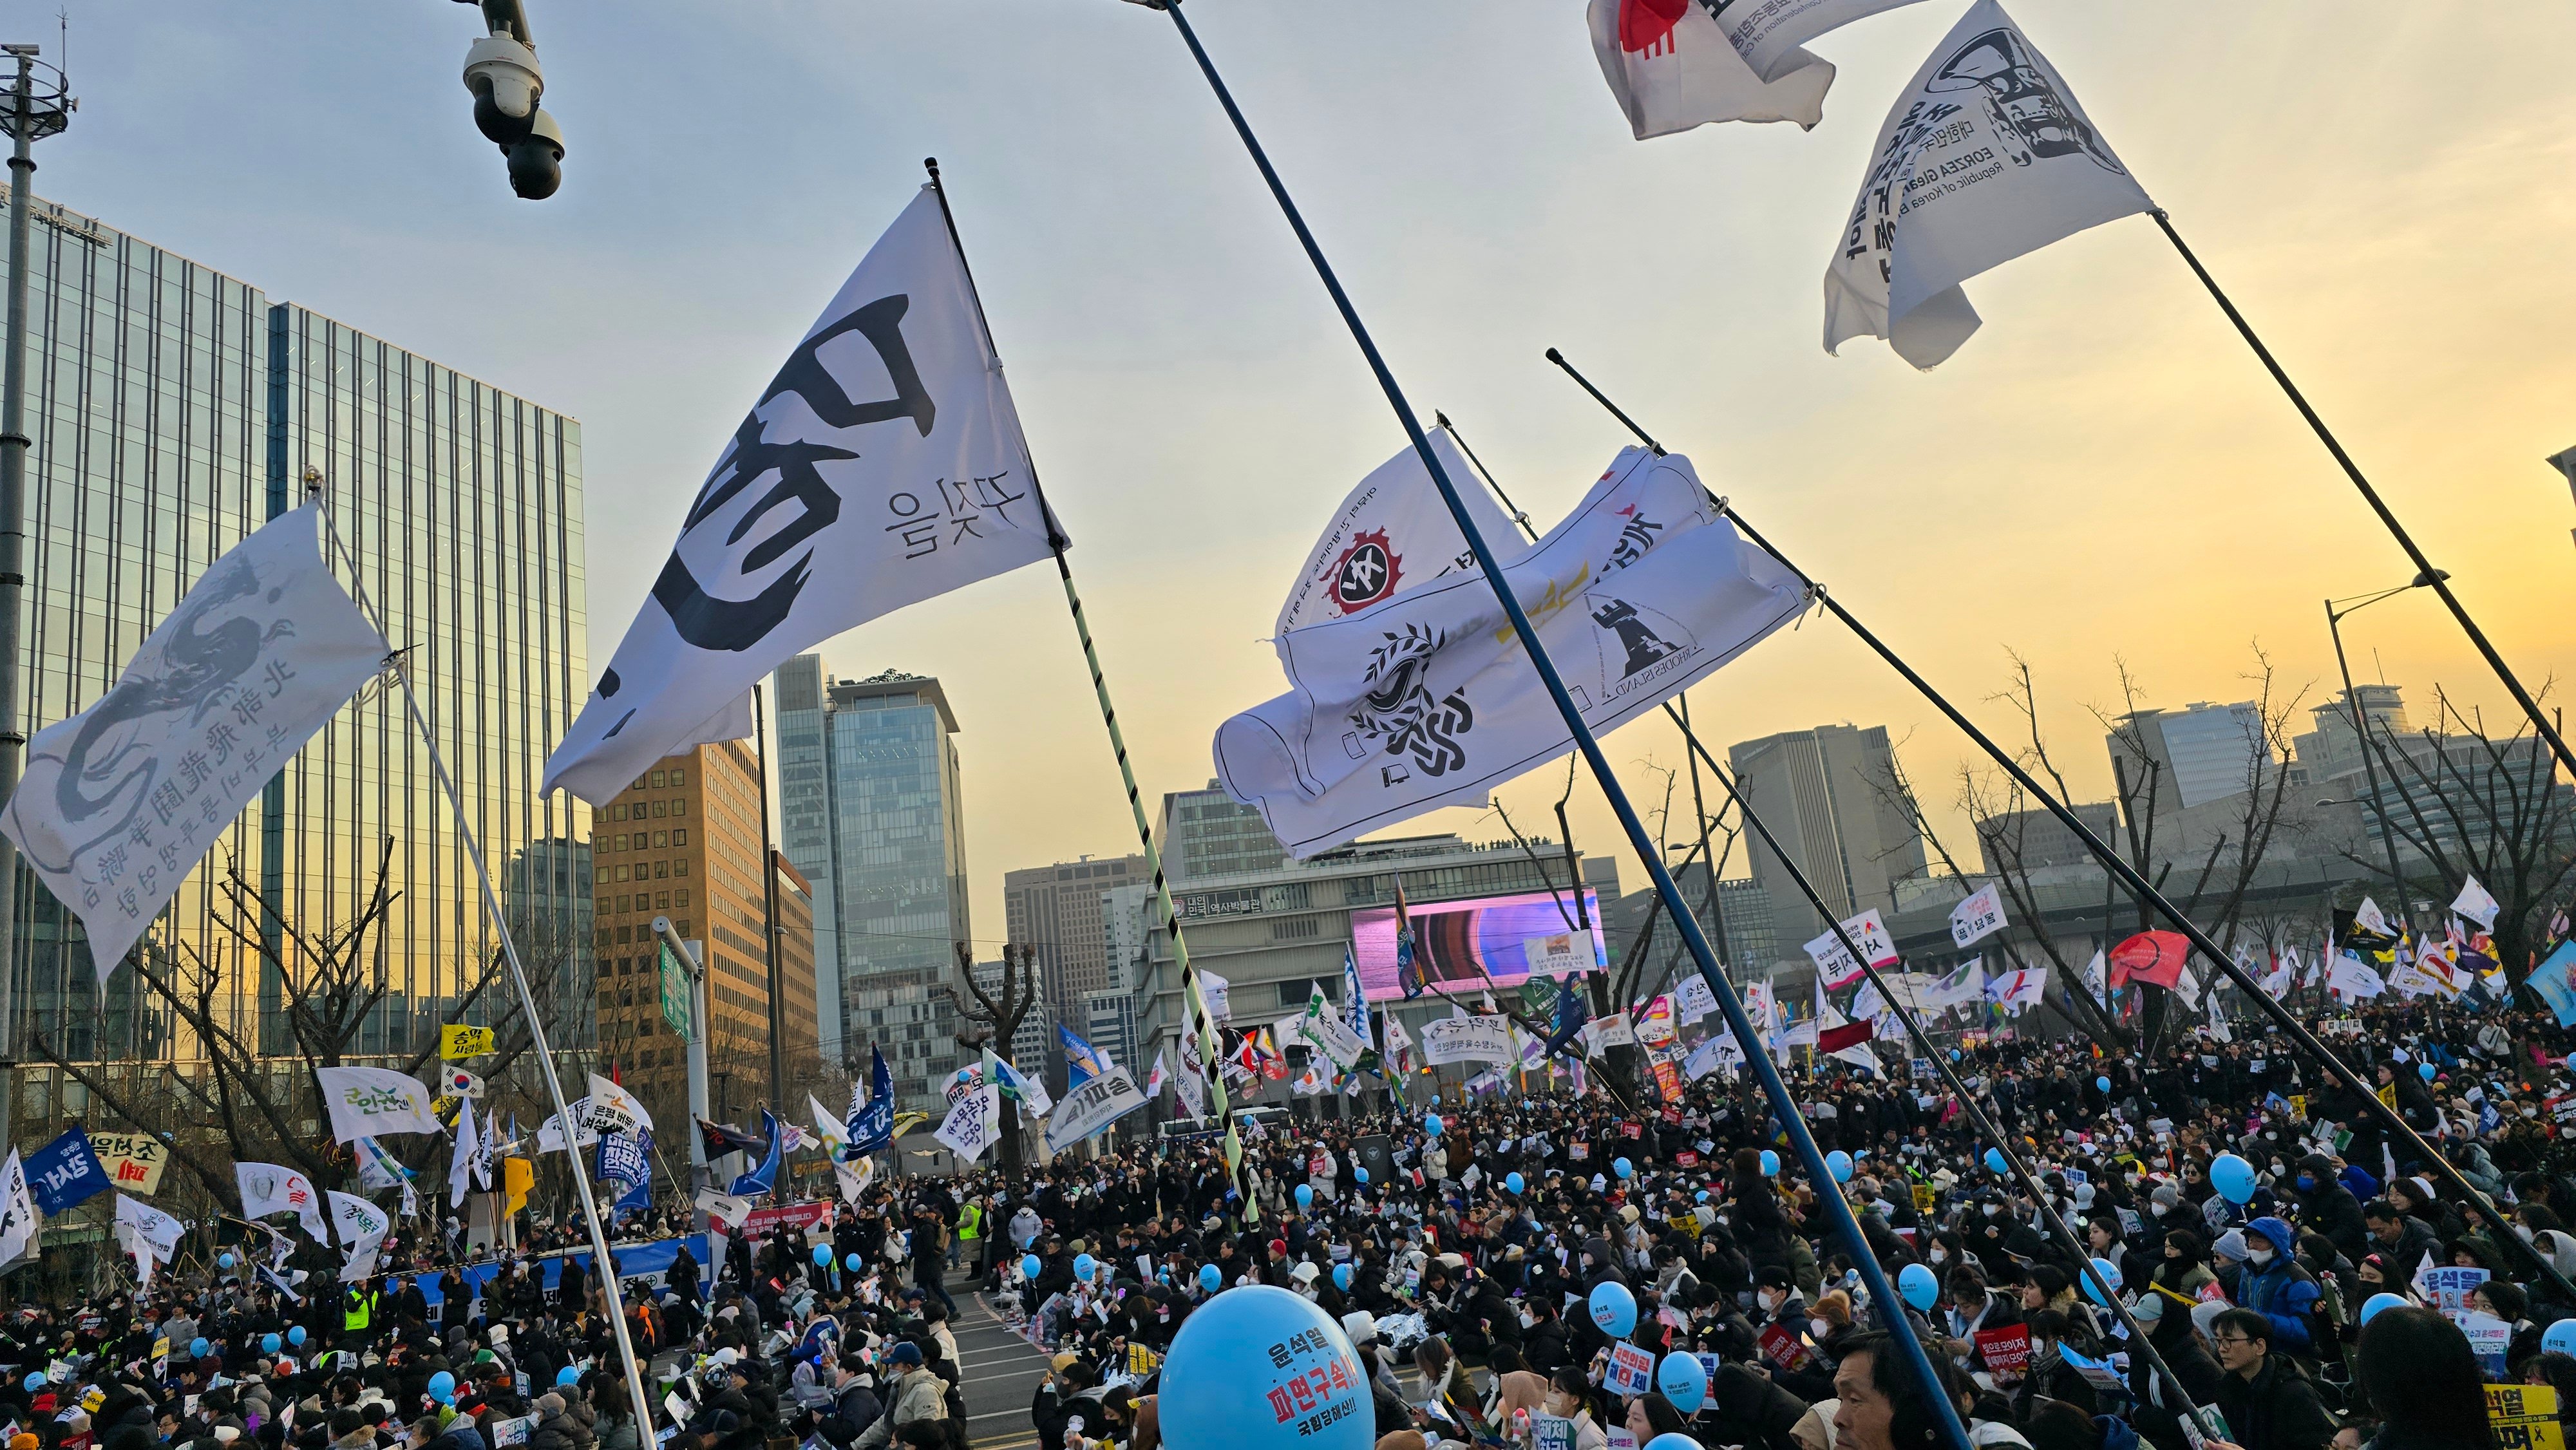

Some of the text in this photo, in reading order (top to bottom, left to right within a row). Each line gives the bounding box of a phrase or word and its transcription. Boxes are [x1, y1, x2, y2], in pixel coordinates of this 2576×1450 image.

[1210, 899, 1261, 914] 역사박물관
[594, 1104, 616, 1119] 은평
[581, 1116, 609, 1131] 여성
[2427, 1270, 2482, 1292] 윤석열
[1268, 1326, 1330, 1370] 윤석열
[2000, 1337, 2026, 1351] 모이자
[1613, 1346, 1651, 1374] 국민의힘
[1266, 1354, 1359, 1424] 파면구속!!
[1297, 1397, 1358, 1437] 국힘당해산!!
[1539, 1420, 1568, 1439] 해체
